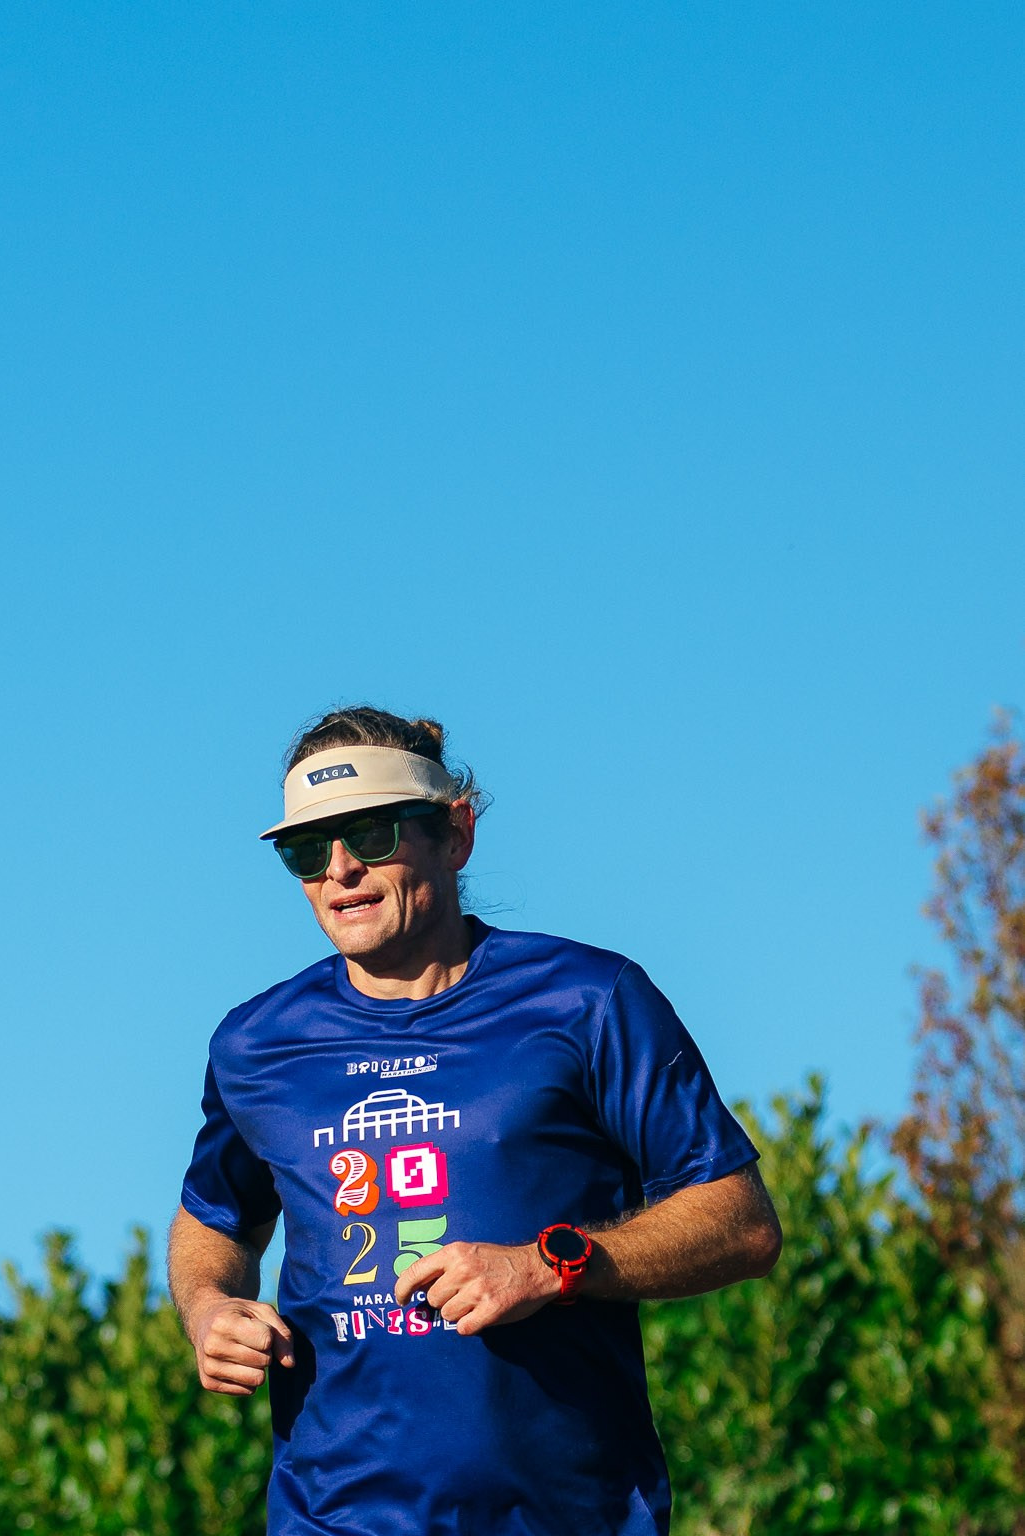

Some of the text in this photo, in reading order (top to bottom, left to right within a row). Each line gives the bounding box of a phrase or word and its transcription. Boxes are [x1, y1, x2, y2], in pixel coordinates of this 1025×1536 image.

[312, 767, 350, 782] VAGA
[345, 1053, 439, 1076] BRIGHTON
[381, 1068, 423, 1077] MARATHON
[353, 1290, 426, 1307] MARAO
